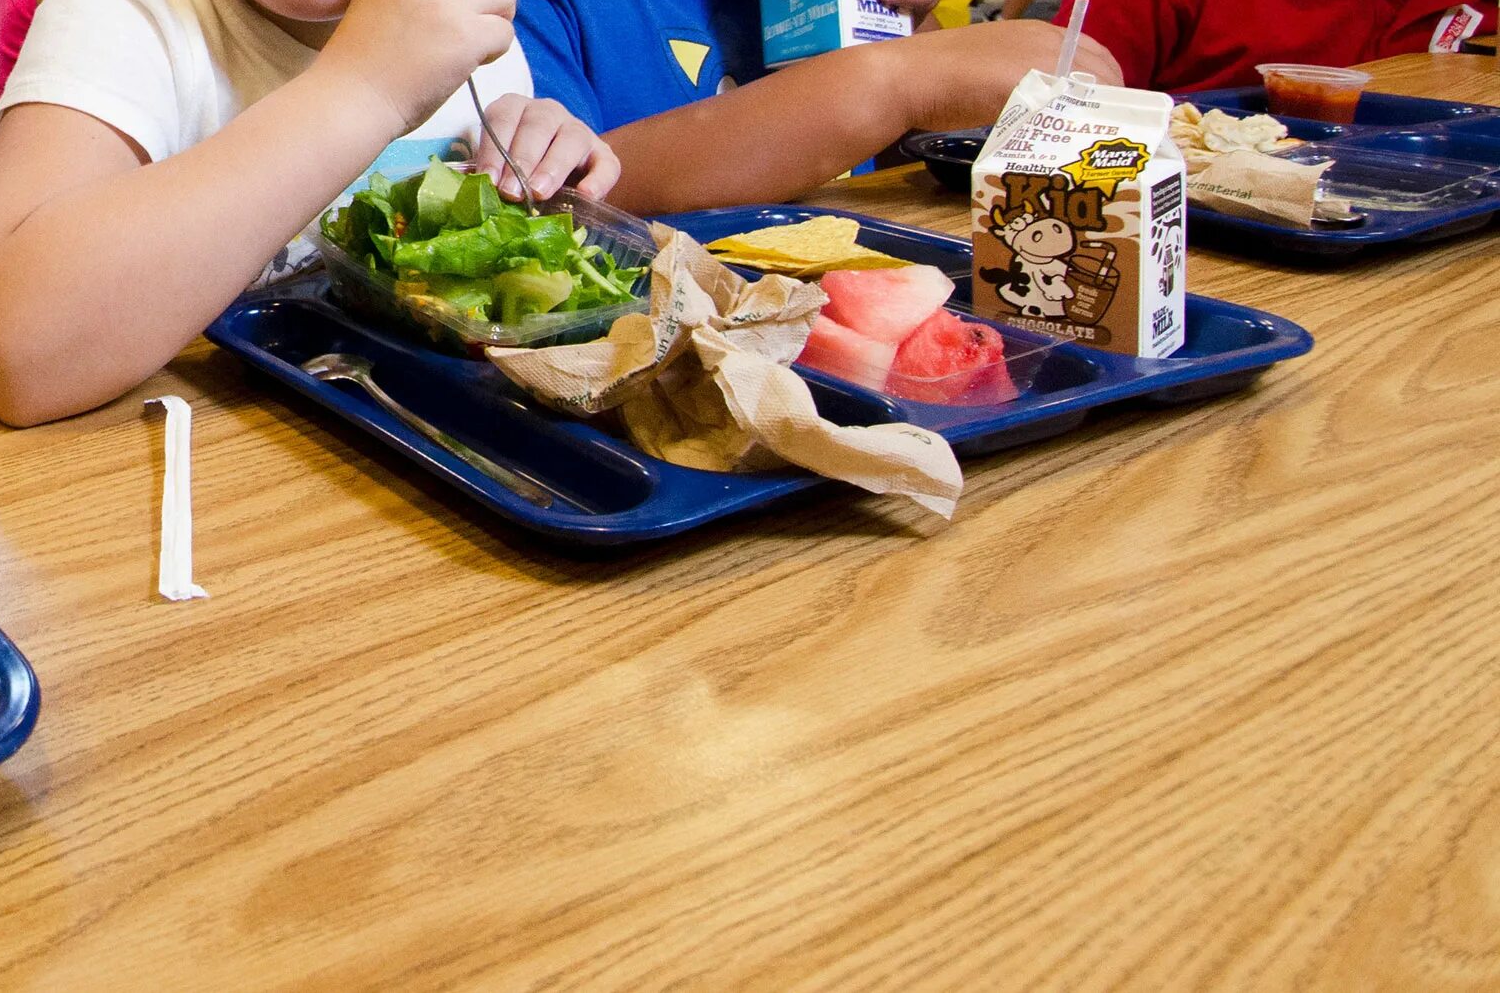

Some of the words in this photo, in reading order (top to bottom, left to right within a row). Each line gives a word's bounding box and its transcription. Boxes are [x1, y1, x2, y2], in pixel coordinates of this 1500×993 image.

[1028, 112, 1120, 136] OCOLATE
[1029, 128, 1072, 144] Free
[1090, 149, 1139, 160] Marva
[1092, 157, 1134, 168] Maid
[1004, 162, 1056, 175] Healthy
[1197, 181, 1253, 200] material
[1002, 173, 1106, 231] Kid
[1007, 316, 1095, 340] CHOCOLATE
